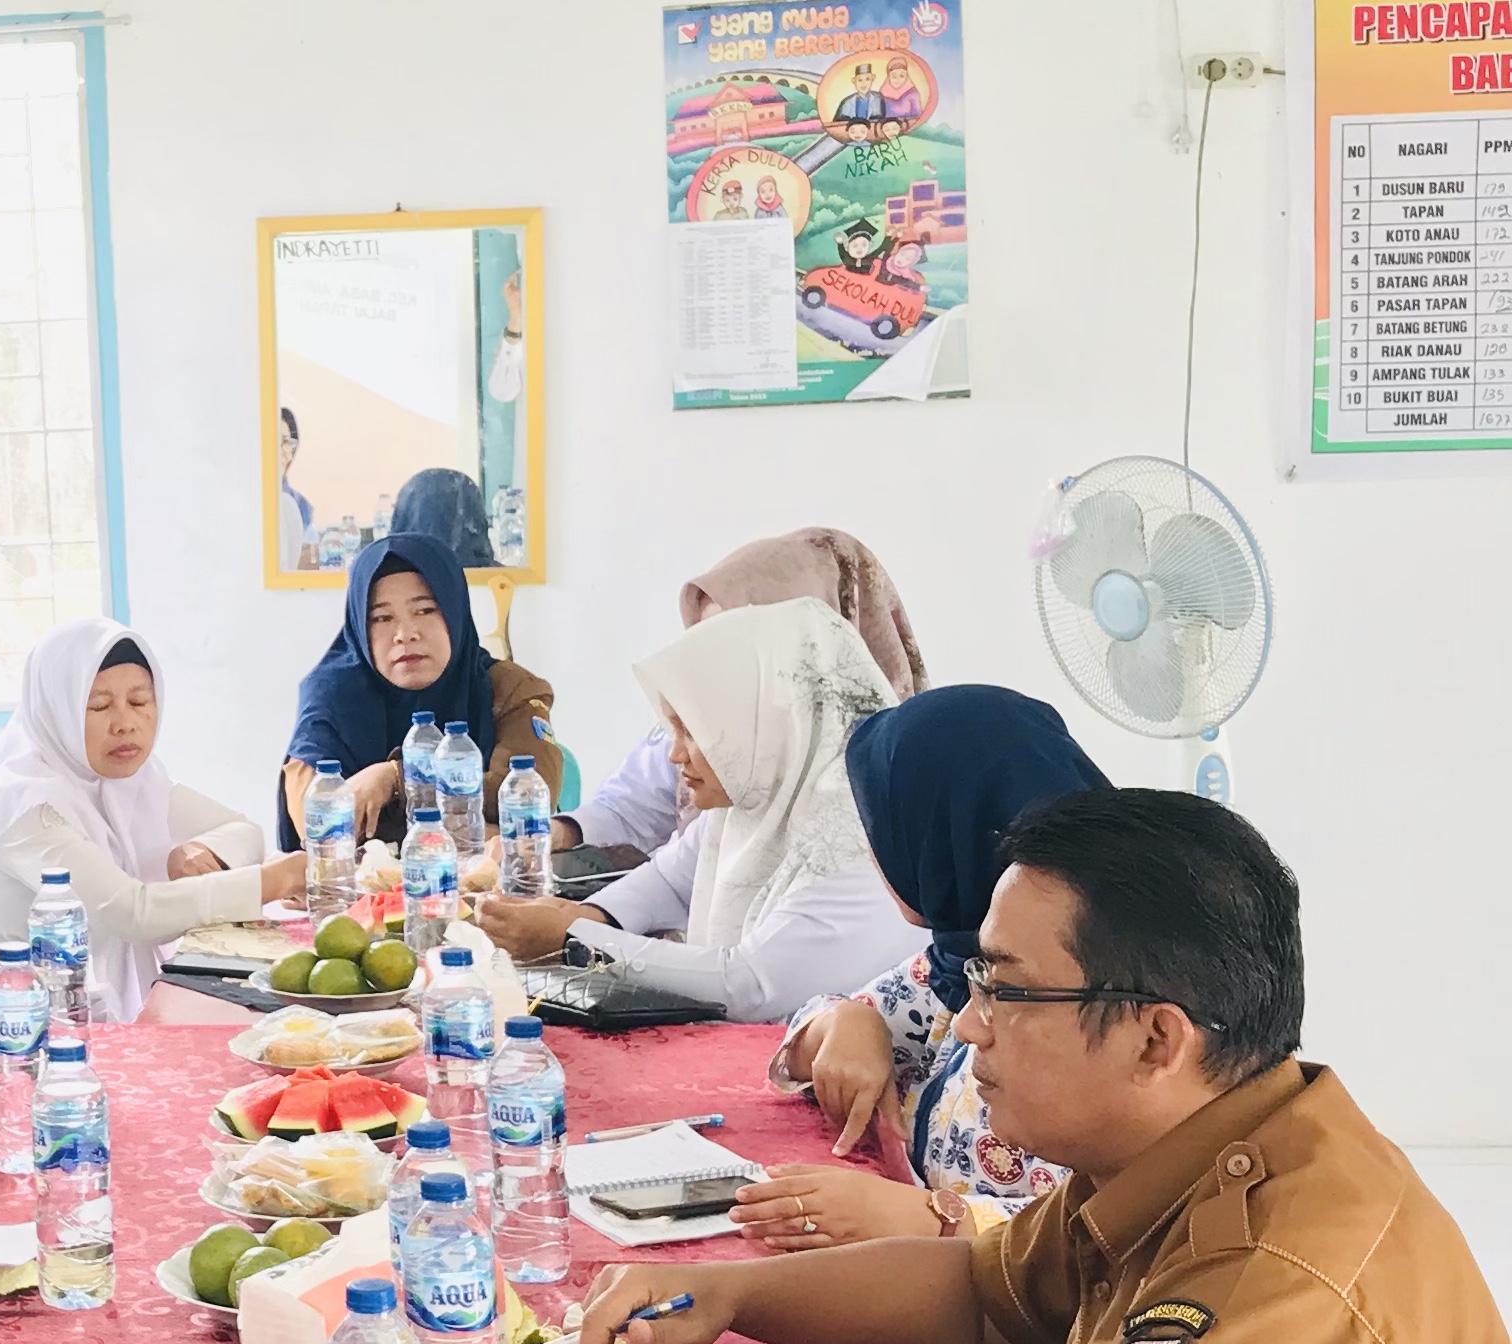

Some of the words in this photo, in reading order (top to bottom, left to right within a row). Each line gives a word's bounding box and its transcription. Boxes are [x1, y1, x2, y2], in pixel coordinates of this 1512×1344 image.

[854, 136, 904, 164] BARU
[1348, 146, 1365, 158] NO
[1398, 142, 1448, 157] NAGARI
[700, 156, 741, 196] KERJA
[746, 149, 790, 172] DULU
[845, 150, 909, 180] NIKAH
[1353, 184, 1360, 196] 1
[1382, 182, 1424, 196] DUSUN
[1429, 181, 1464, 194] BARU
[1351, 208, 1360, 220] 2
[1402, 205, 1444, 219] TAPAN
[1351, 231, 1360, 244] 3
[1386, 229, 1420, 243] KOTO
[1424, 228, 1460, 241] ANAU
[1351, 254, 1360, 267] 4
[1374, 252, 1423, 266] TANJUNG
[1427, 250, 1471, 265] PONDOK
[1351, 277, 1359, 289] 5
[1377, 275, 1428, 289] BATANG
[1432, 274, 1468, 287] ARAH
[821, 269, 890, 314] SEKOLAH
[1350, 300, 1359, 312] 6
[1377, 299, 1421, 312] PASAR
[1425, 298, 1467, 311] TAPAN
[1350, 323, 1359, 336] 7
[1376, 322, 1420, 335] BATANG
[1424, 320, 1467, 334] BETUNG
[1350, 346, 1359, 359] 8
[1381, 345, 1413, 358] RIAK
[1417, 343, 1462, 357] DANAU
[1350, 369, 1358, 382] 9
[1372, 367, 1426, 381] AMPANG
[1431, 366, 1470, 380] TULAK
[1346, 392, 1361, 405] 10
[1383, 390, 1425, 404] BUKIT
[1427, 389, 1458, 403] BUAI
[1393, 412, 1448, 426] JUMLAH
[491, 1102, 536, 1127] AQUA
[430, 1280, 487, 1309] AQUA
